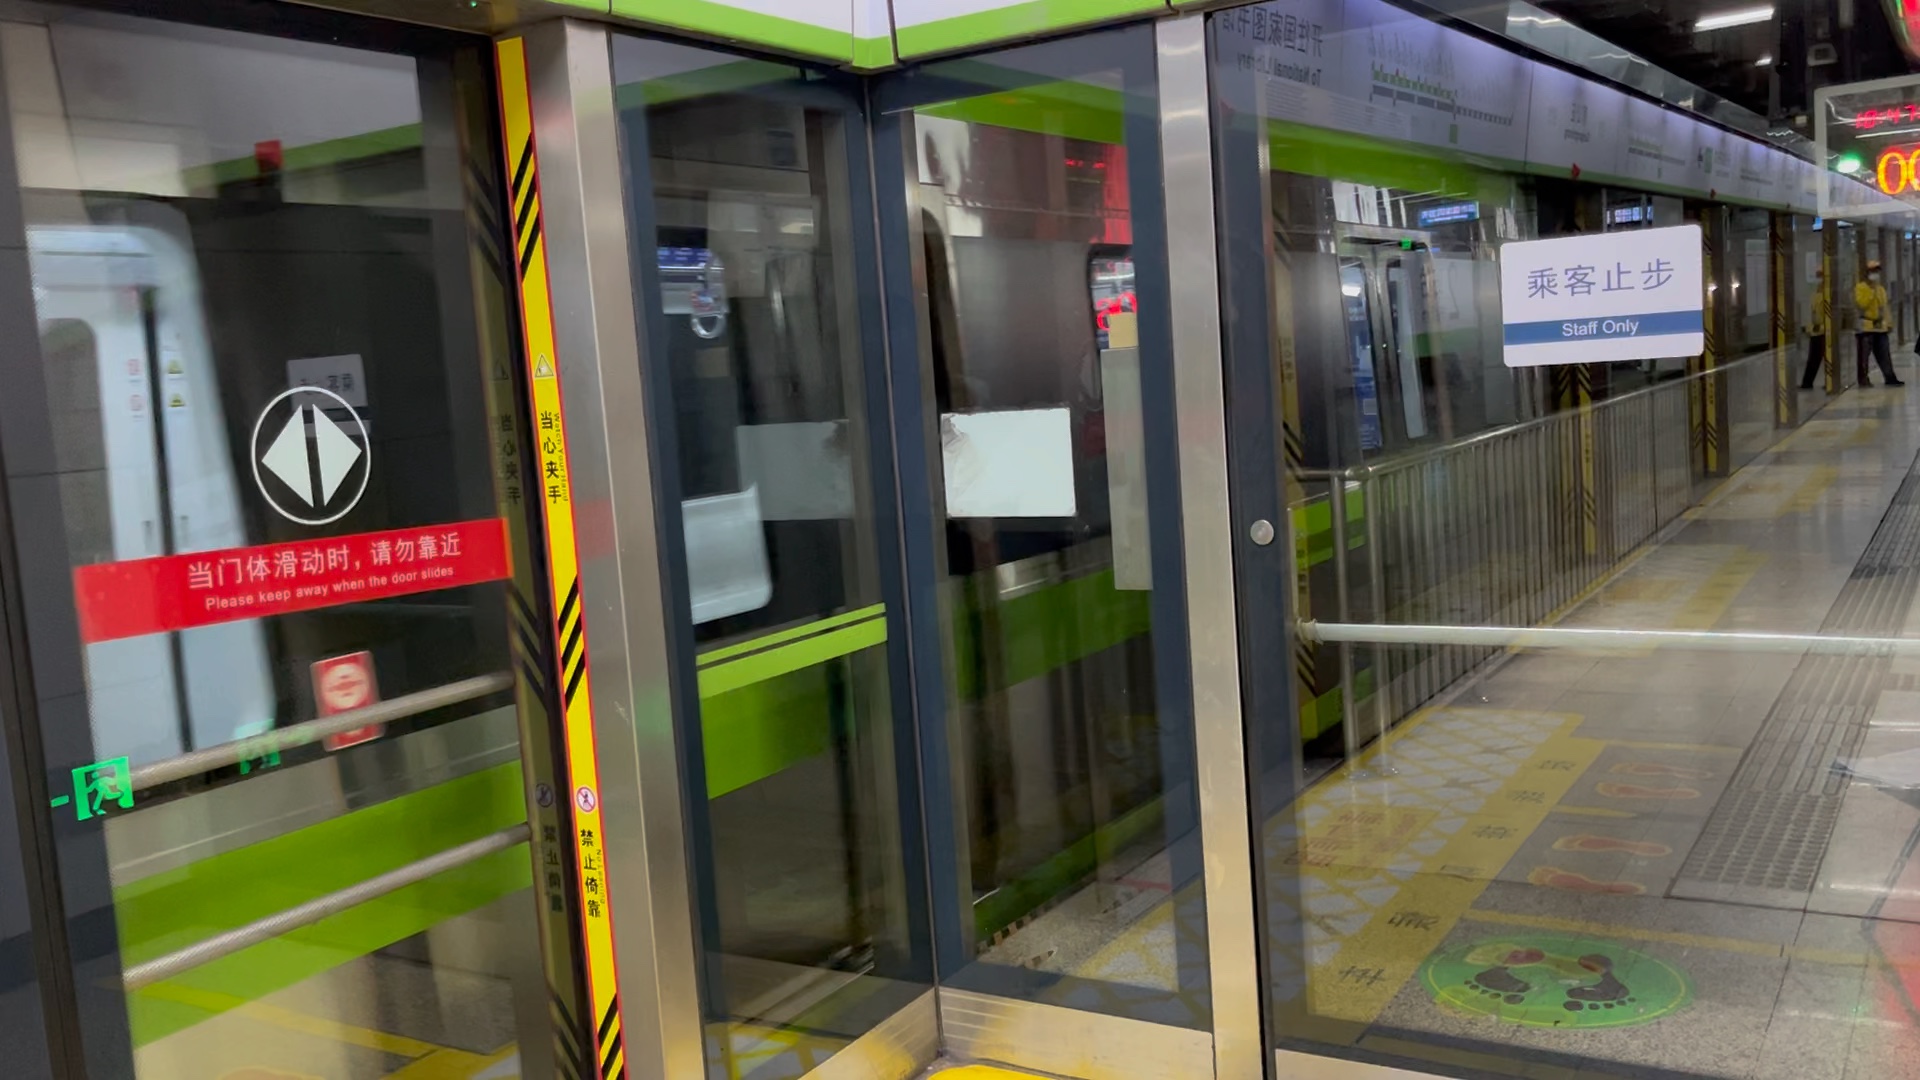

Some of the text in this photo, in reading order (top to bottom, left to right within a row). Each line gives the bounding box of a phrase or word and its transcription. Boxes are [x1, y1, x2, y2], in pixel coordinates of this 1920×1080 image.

[1527, 258, 1675, 299] 乘客止步
[1562, 319, 1640, 337] Staff Only
[541, 410, 561, 504] 当心夹手
[188, 532, 462, 590] 当门体滑动时，请勿靠近
[205, 565, 455, 611] Please keep away when the door slides
[580, 828, 601, 917] 禁止倚靠
